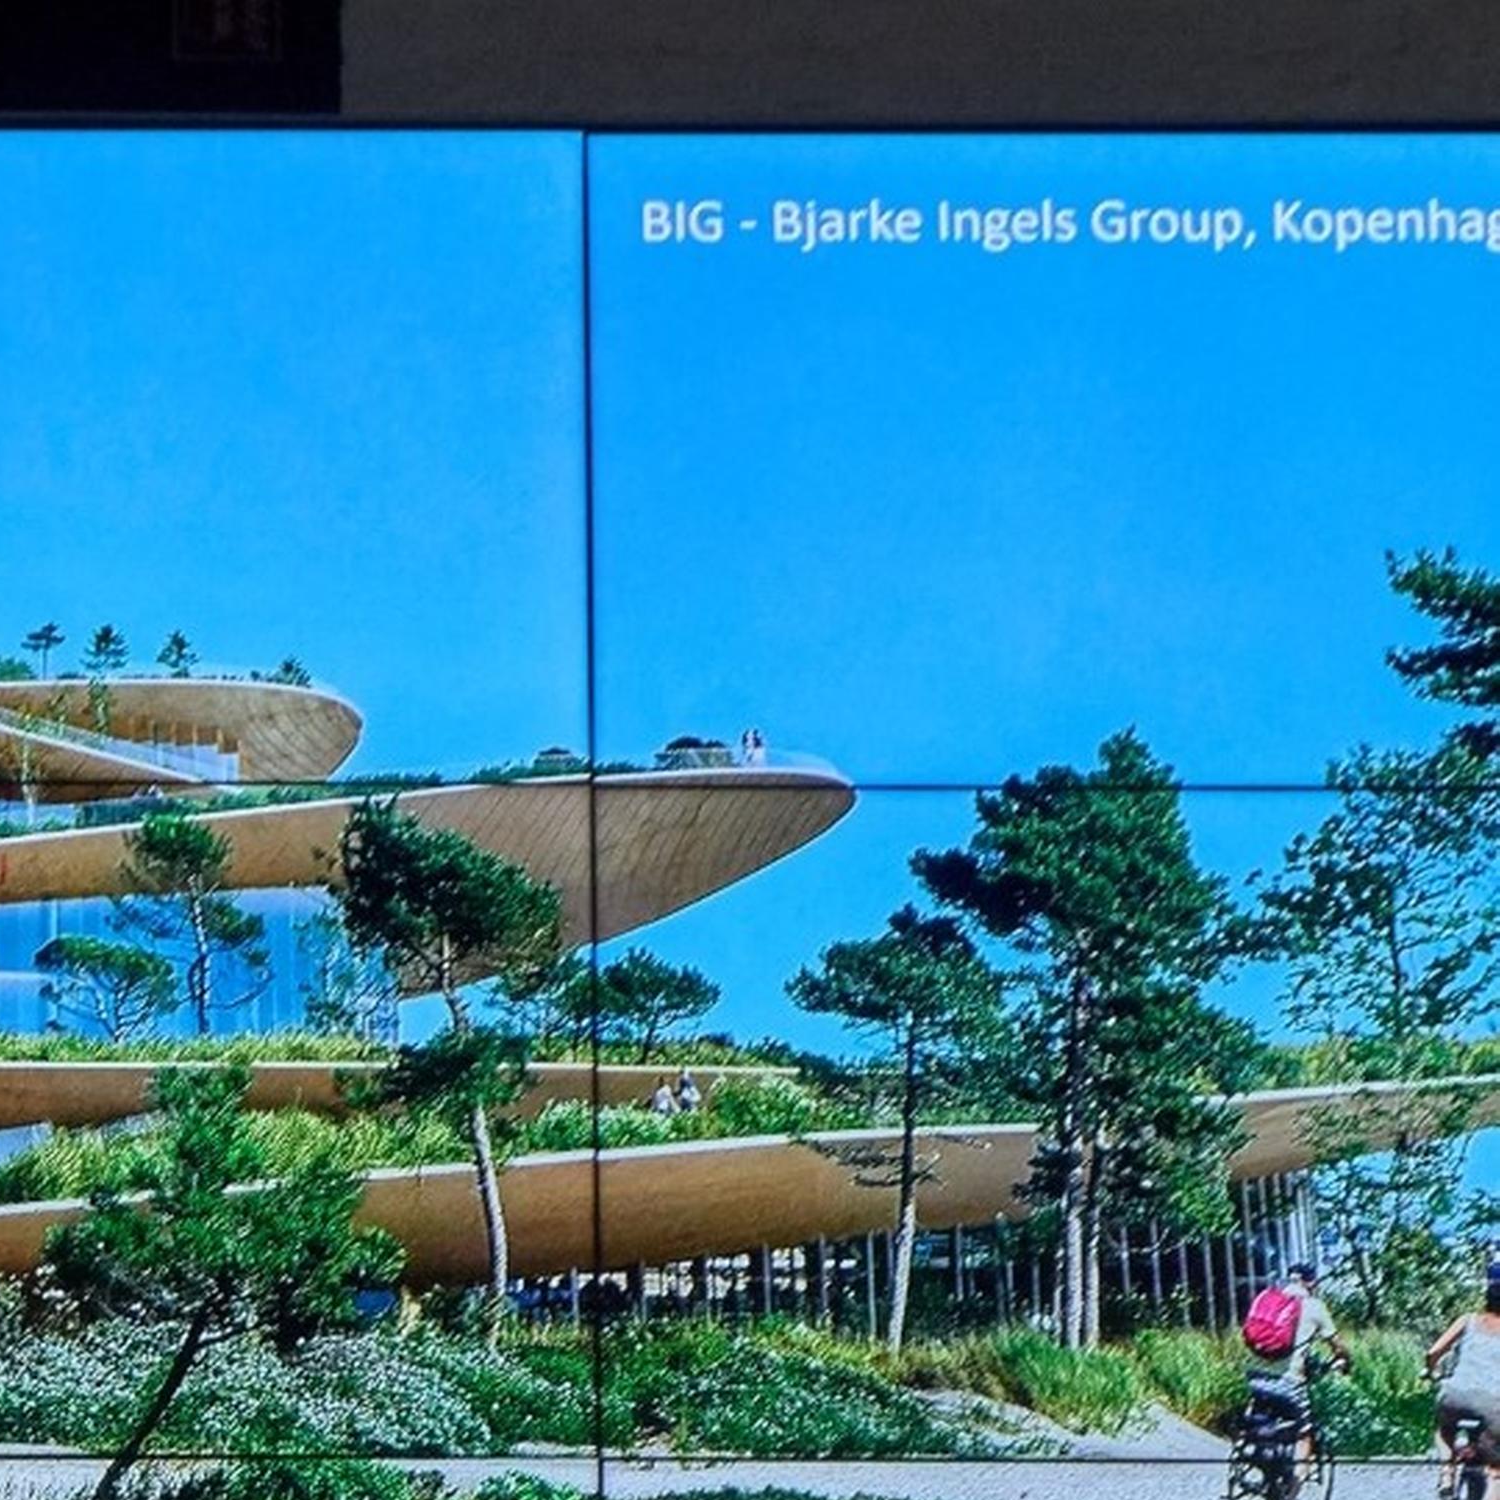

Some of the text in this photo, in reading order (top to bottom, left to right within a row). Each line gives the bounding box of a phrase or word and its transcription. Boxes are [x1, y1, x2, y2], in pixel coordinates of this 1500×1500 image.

[642, 199, 724, 243] BIG
[772, 198, 923, 252] Bjarke
[938, 198, 1077, 252] Ingels
[1091, 198, 1256, 253] Group,
